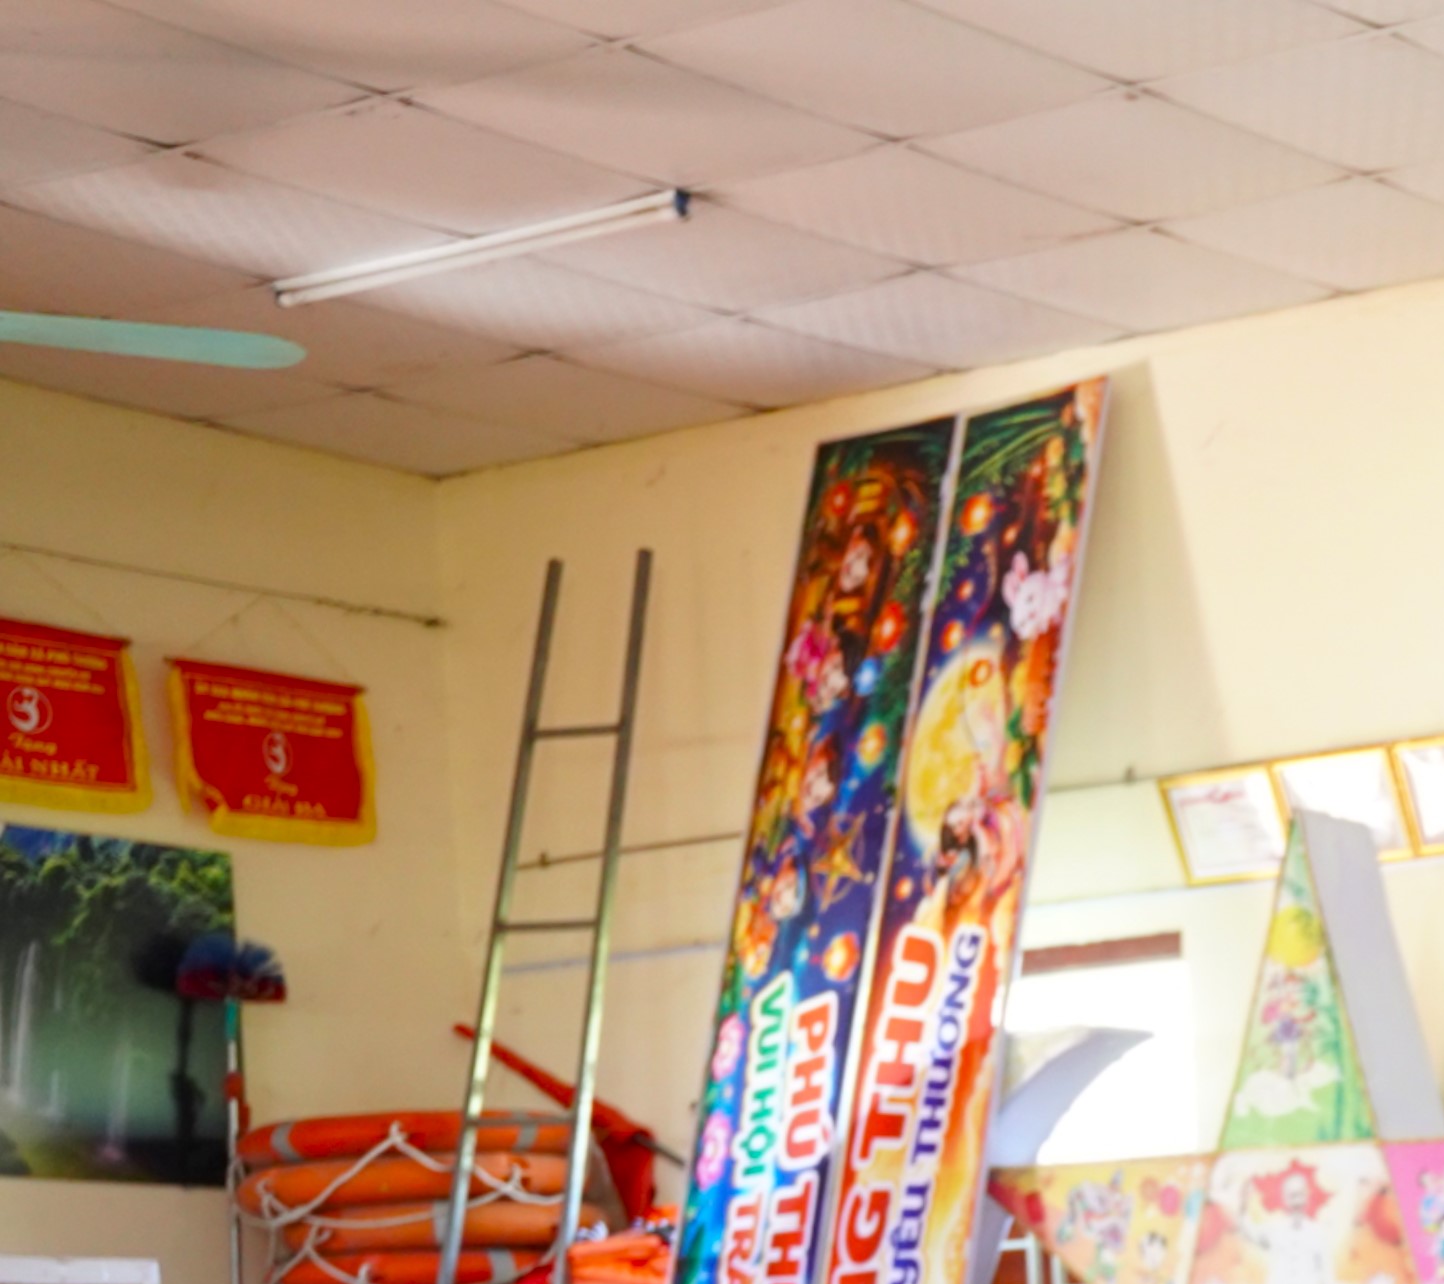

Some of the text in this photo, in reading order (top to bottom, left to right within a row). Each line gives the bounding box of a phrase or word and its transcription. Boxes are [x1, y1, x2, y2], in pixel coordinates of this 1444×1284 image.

[756, 979, 787, 1074] VUI
[785, 1002, 832, 1160] PHÚ
[859, 934, 938, 1162] THU
[911, 933, 981, 1166] THƯƠNG
[740, 1086, 777, 1177] HỘI
